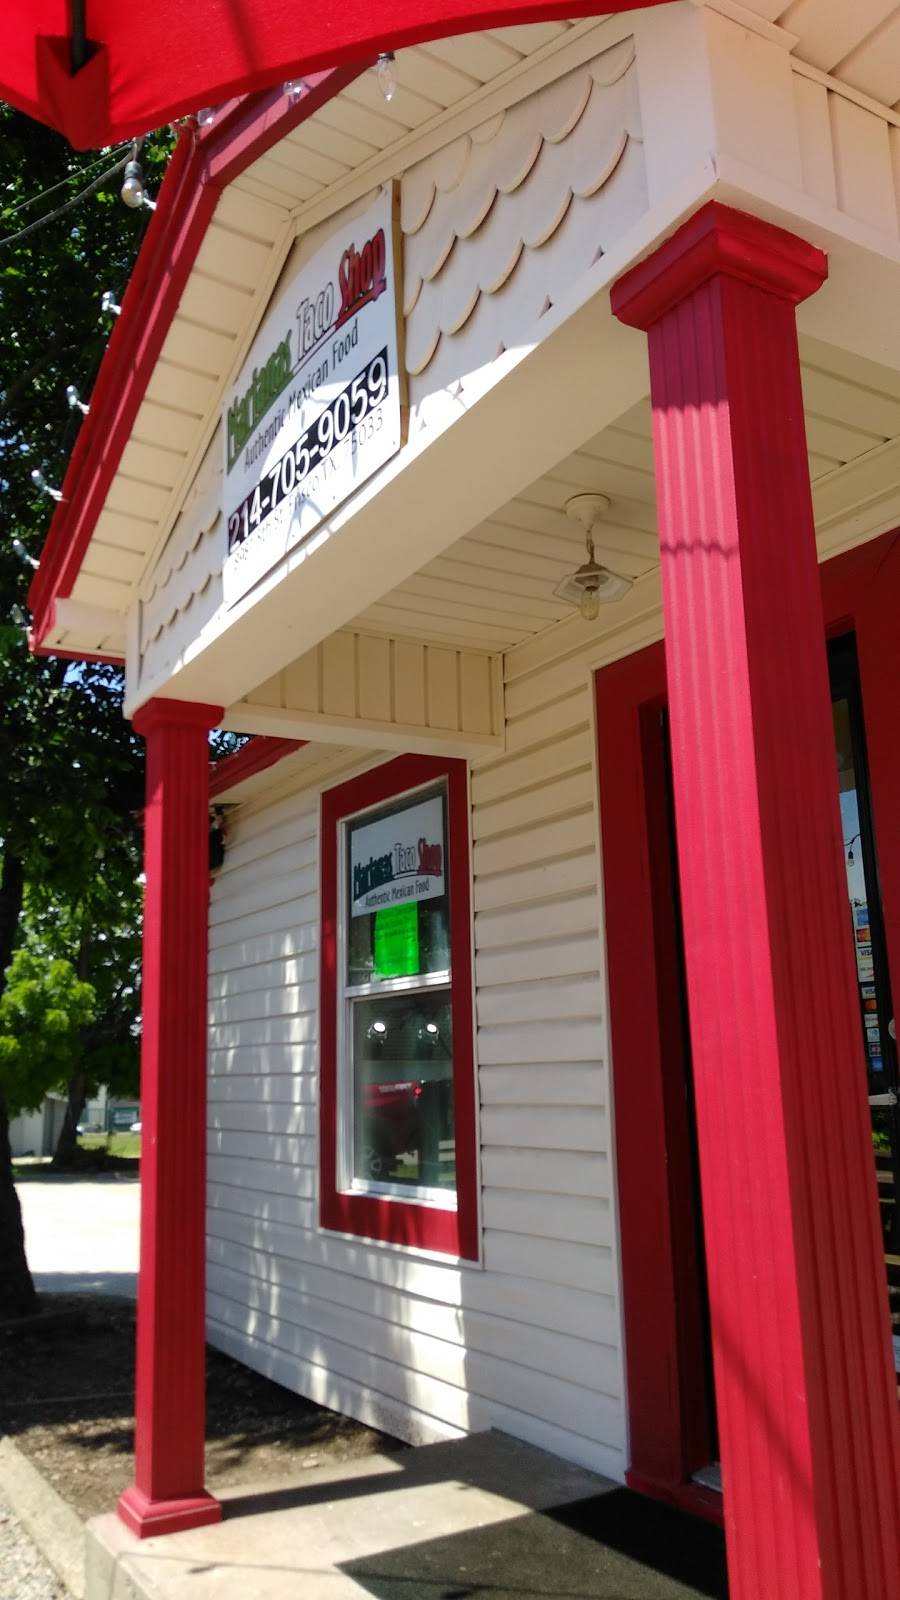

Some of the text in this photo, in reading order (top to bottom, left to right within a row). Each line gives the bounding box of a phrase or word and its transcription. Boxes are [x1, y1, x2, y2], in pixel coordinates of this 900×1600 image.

[296, 281, 335, 361] Taco
[339, 228, 387, 318] Shop
[229, 356, 387, 554] 214-705-9059
[244, 317, 359, 471] Authentic Mexican Food
[392, 884, 414, 899] Mexican
[415, 878, 430, 893] Food
